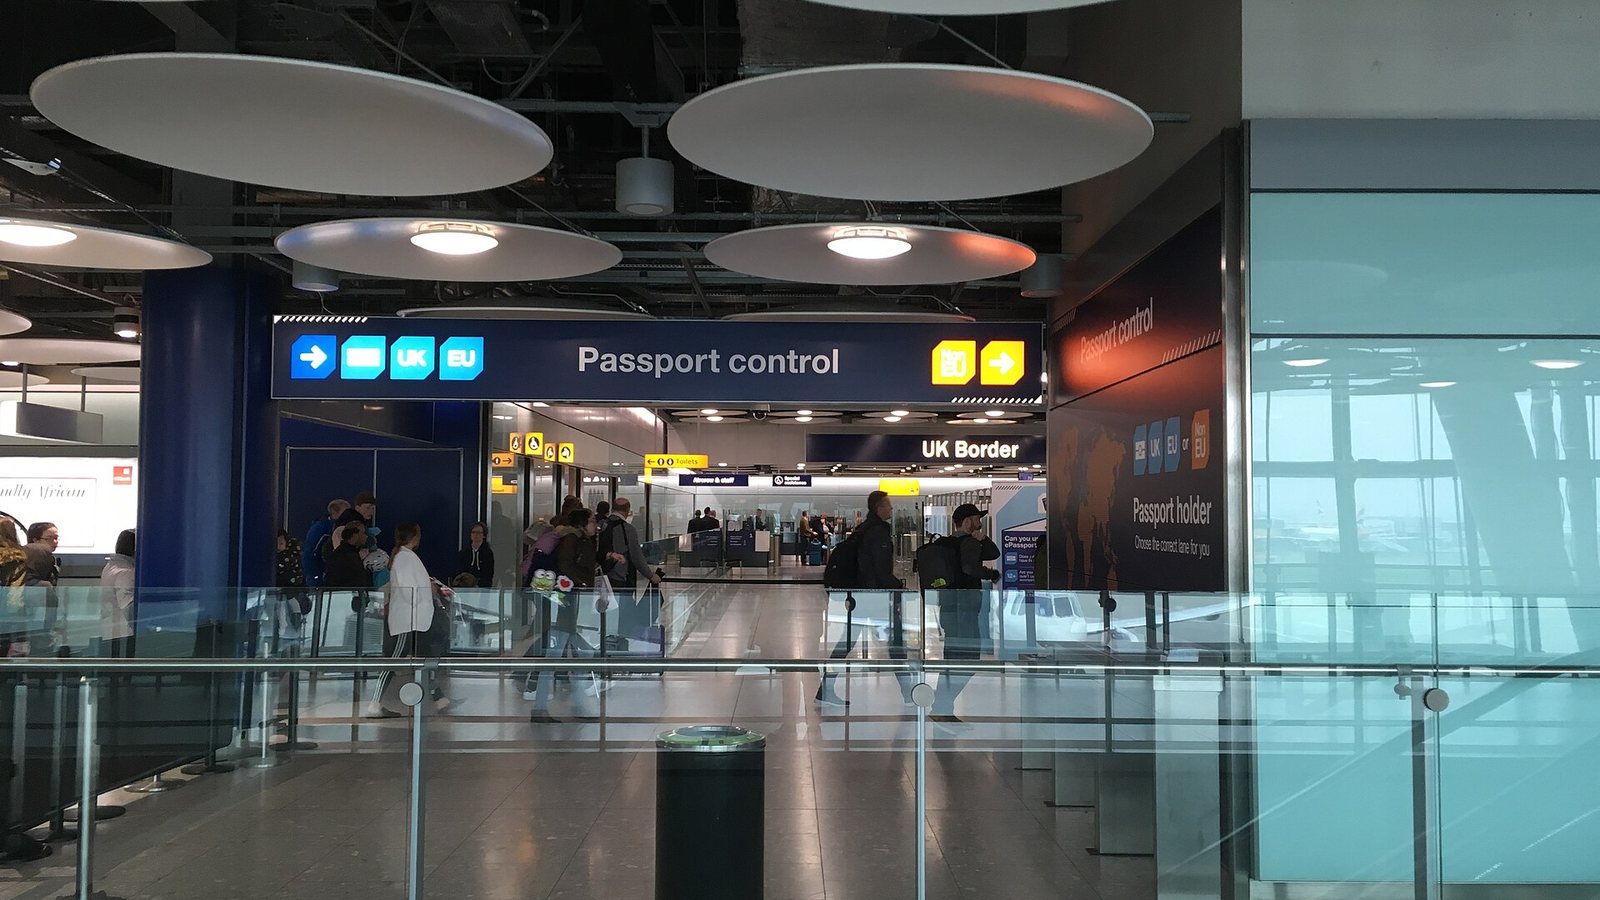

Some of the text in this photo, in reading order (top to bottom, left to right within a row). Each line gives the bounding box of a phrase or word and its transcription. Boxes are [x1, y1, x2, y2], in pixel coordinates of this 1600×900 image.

[1080, 297, 1153, 365] Passport control
[398, 350, 476, 368] UK EU
[578, 346, 839, 378] Passport control
[940, 360, 967, 377] EU
[1194, 422, 1205, 436] Non
[922, 440, 1019, 459] UK Border
[1150, 435, 1190, 457] UK EU or
[1195, 438, 1206, 458] EU
[39, 484, 85, 499] African
[1133, 495, 1212, 529] Passport holder
[1134, 534, 1210, 559] Choose the correct lane for you
